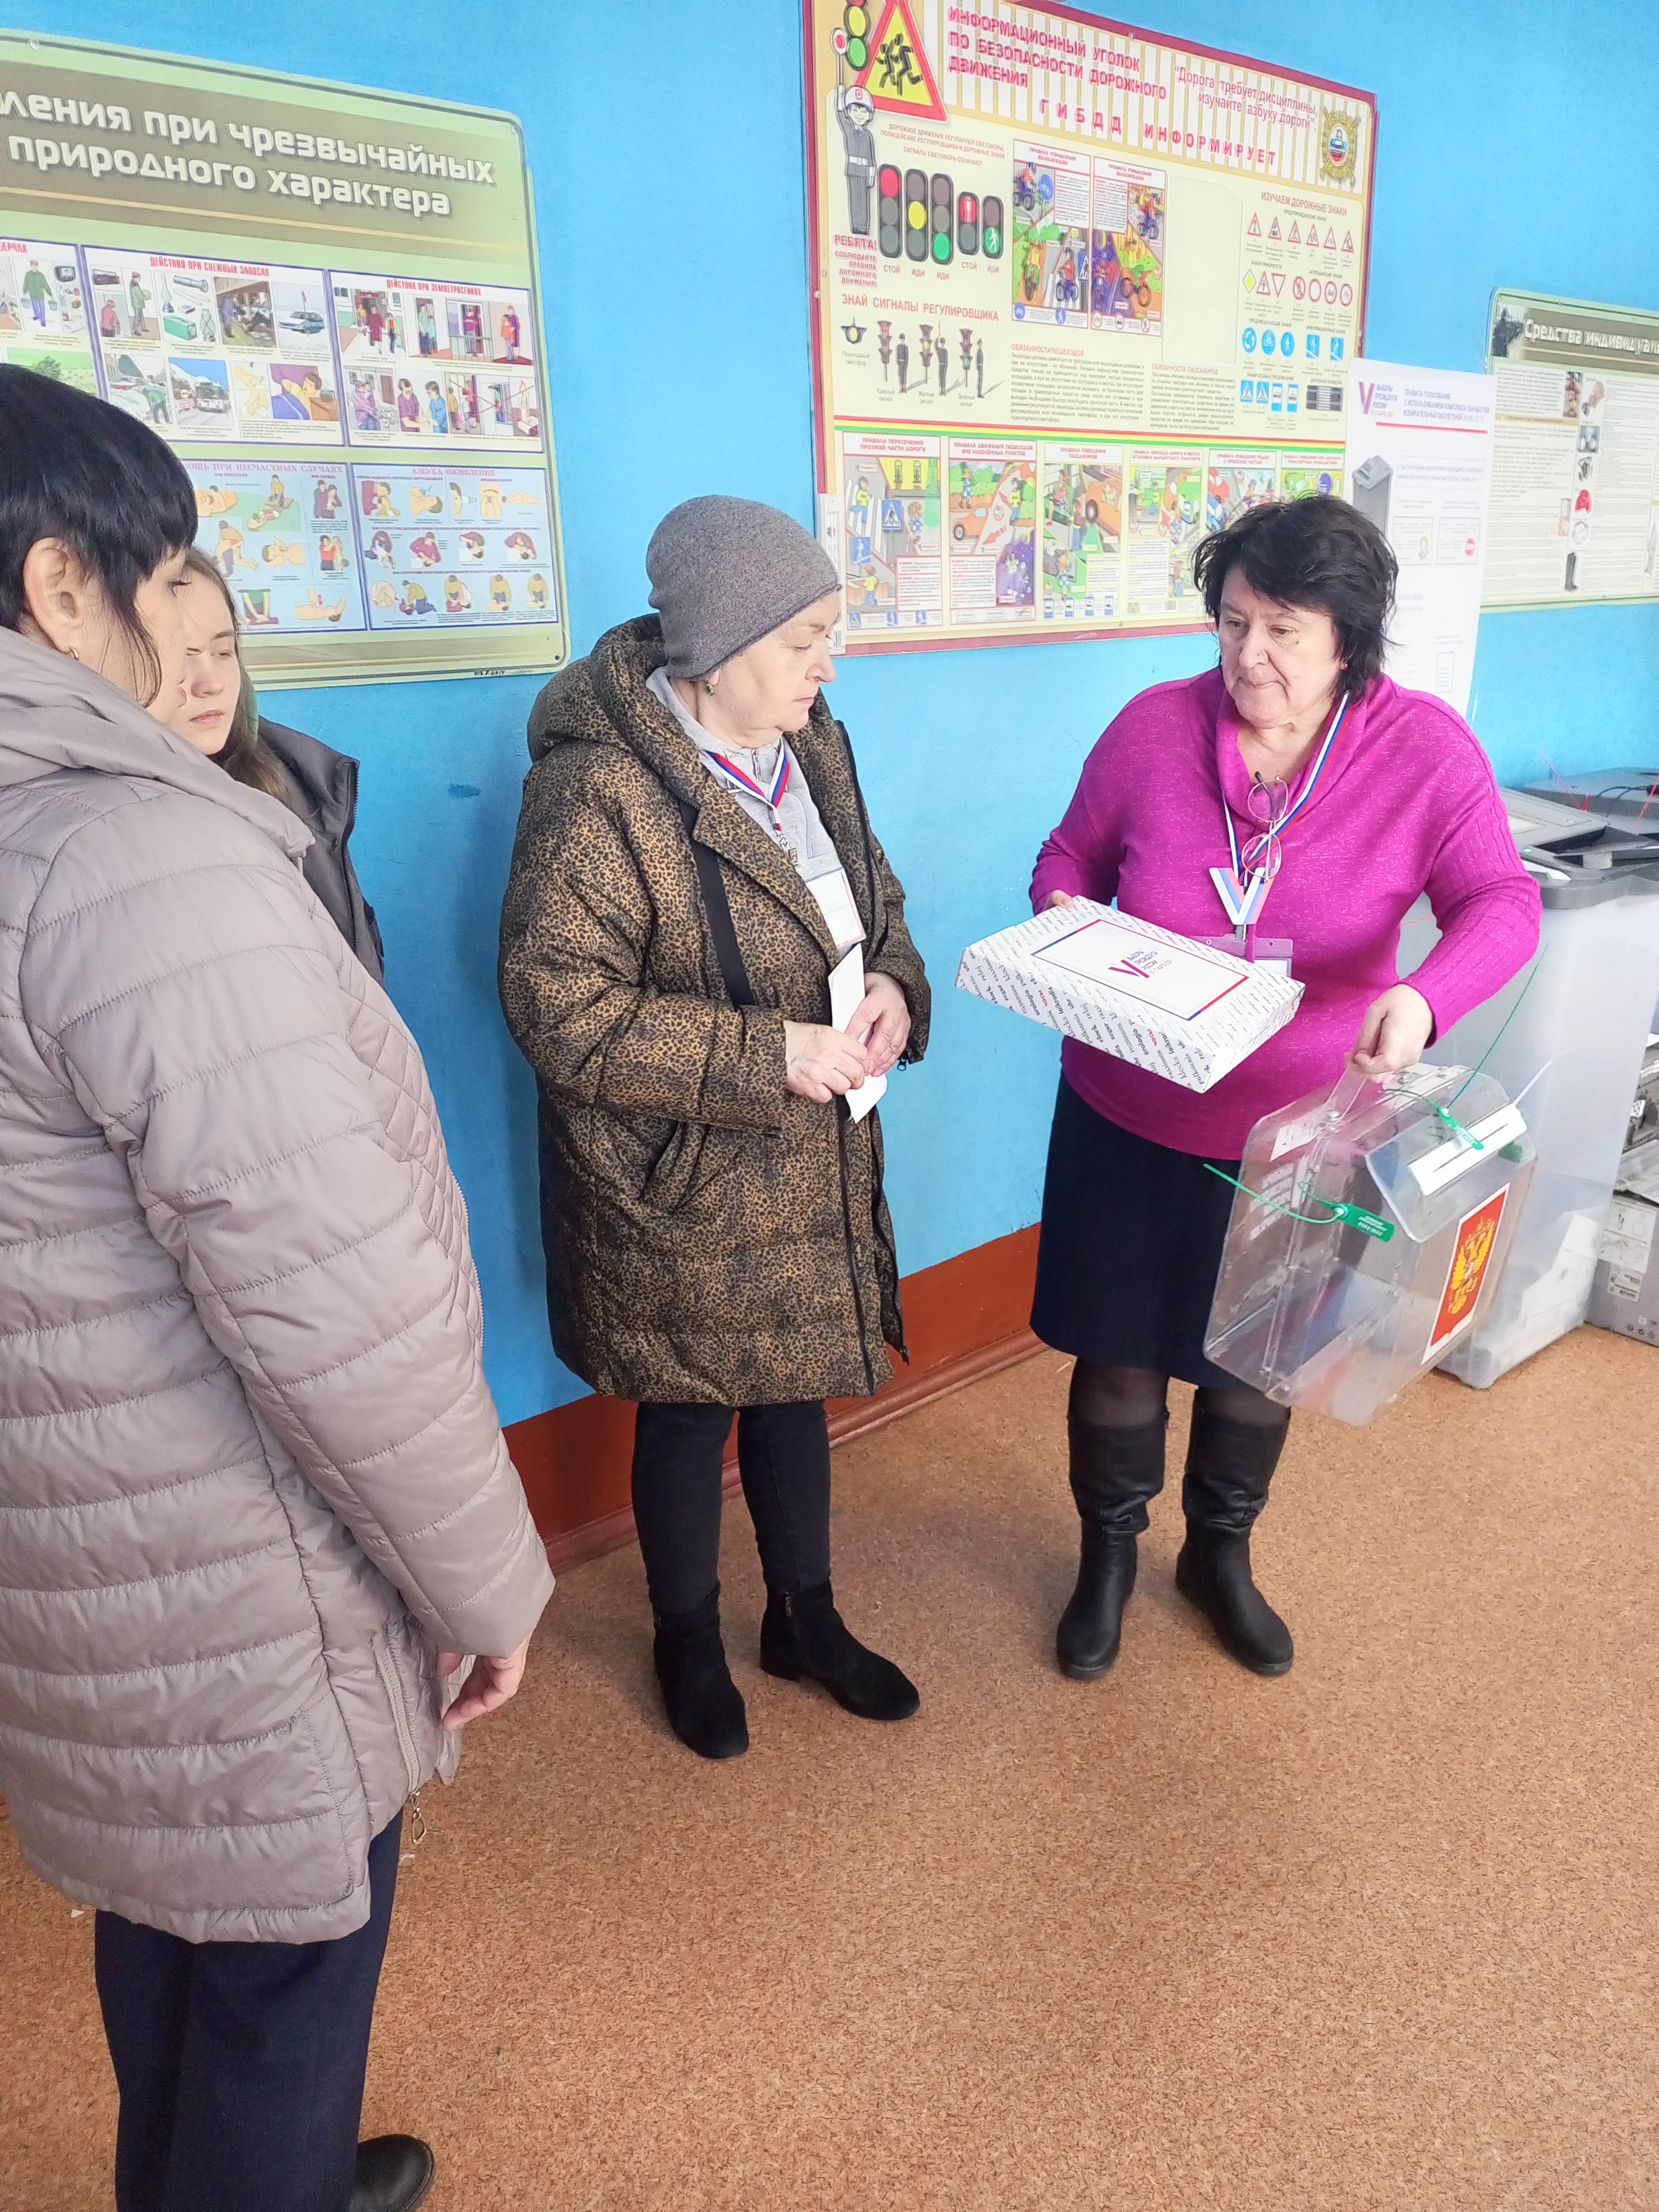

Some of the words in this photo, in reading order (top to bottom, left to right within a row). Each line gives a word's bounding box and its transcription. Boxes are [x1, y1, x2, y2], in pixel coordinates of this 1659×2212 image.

[948, 6, 1086, 58] ИНФОРМАЦИОННЫЙ
[1092, 46, 1141, 72] УГОЛОК
[948, 31, 970, 49] ПО
[976, 37, 1084, 80] БЕЗОПАСНОСТИ
[1089, 68, 1167, 100] ДОРОЖНОГО
[948, 55, 1029, 88] ДВИЖЕНИЯ
[1199, 91, 1242, 112] изучайте
[1248, 104, 1278, 124] азбуку
[1220, 80, 1257, 100] требует
[1259, 90, 1318, 118] дисциплины,
[0, 90, 133, 132] ления
[142, 110, 218, 146] при
[226, 122, 495, 185] чрезвычайных
[889, 123, 917, 134] ДОРОЖНОЕ
[918, 129, 944, 139] ДВИЖЕНИЕ
[945, 134, 974, 145] РЕГУЛИРУЮТ
[903, 146, 927, 157] СИГНАЛЫ
[928, 149, 957, 162] СВЕТОФОРА
[957, 156, 982, 166] ОЗНАЧАЮТ
[7, 135, 256, 190] природного
[264, 168, 451, 218] характера
[1261, 191, 1290, 205] ИЗУЧАЕМ
[1291, 198, 1327, 212] ДОРОЖНЫЕ
[1328, 205, 1347, 216] ЗНАКИ
[834, 235, 877, 251] РЕБЯТА!
[150, 256, 186, 269] ДЕЙСТВИЯ
[188, 260, 202, 270] ПРИ
[204, 262, 238, 274] СНЕЖНЫХ
[835, 251, 876, 261] СОБЛЮДАЙТЕ
[848, 261, 876, 270] ПРАВИЛА
[961, 261, 977, 270] СТОЙ
[839, 268, 876, 279] ДОРОЖНОГО
[884, 264, 900, 274] СТОЙ
[911, 268, 925, 278] ЖДИ
[937, 271, 949, 280] ИДИ
[987, 265, 1000, 274] ИДИ
[842, 293, 868, 307] ЗНАЙ
[872, 297, 919, 313] СИГНАЛЫ
[923, 303, 999, 321] РЕГУЛИРОВЩИКА
[1524, 318, 1583, 345] Средства
[1011, 343, 1051, 353] ОБЯЗАННОСТИ
[1051, 348, 1084, 357] ПЕШЕХОДОВ
[975, 966, 986, 981] reloj
[998, 985, 1008, 1001] zegar
[1025, 990, 1040, 1015] orologio
[1038, 990, 1047, 1006] часы
[1048, 987, 1064, 1014] laikrodis
[1080, 1003, 1092, 1019] reloj
[1074, 1014, 1093, 1045] pulkstenis
[1104, 1023, 1115, 1040] zegar
[1147, 1029, 1157, 1046] часы
[1133, 1029, 1148, 1055] orologio
[1173, 1056, 1187, 1079] klocka
[1185, 1054, 1204, 1084] pulkstenis
